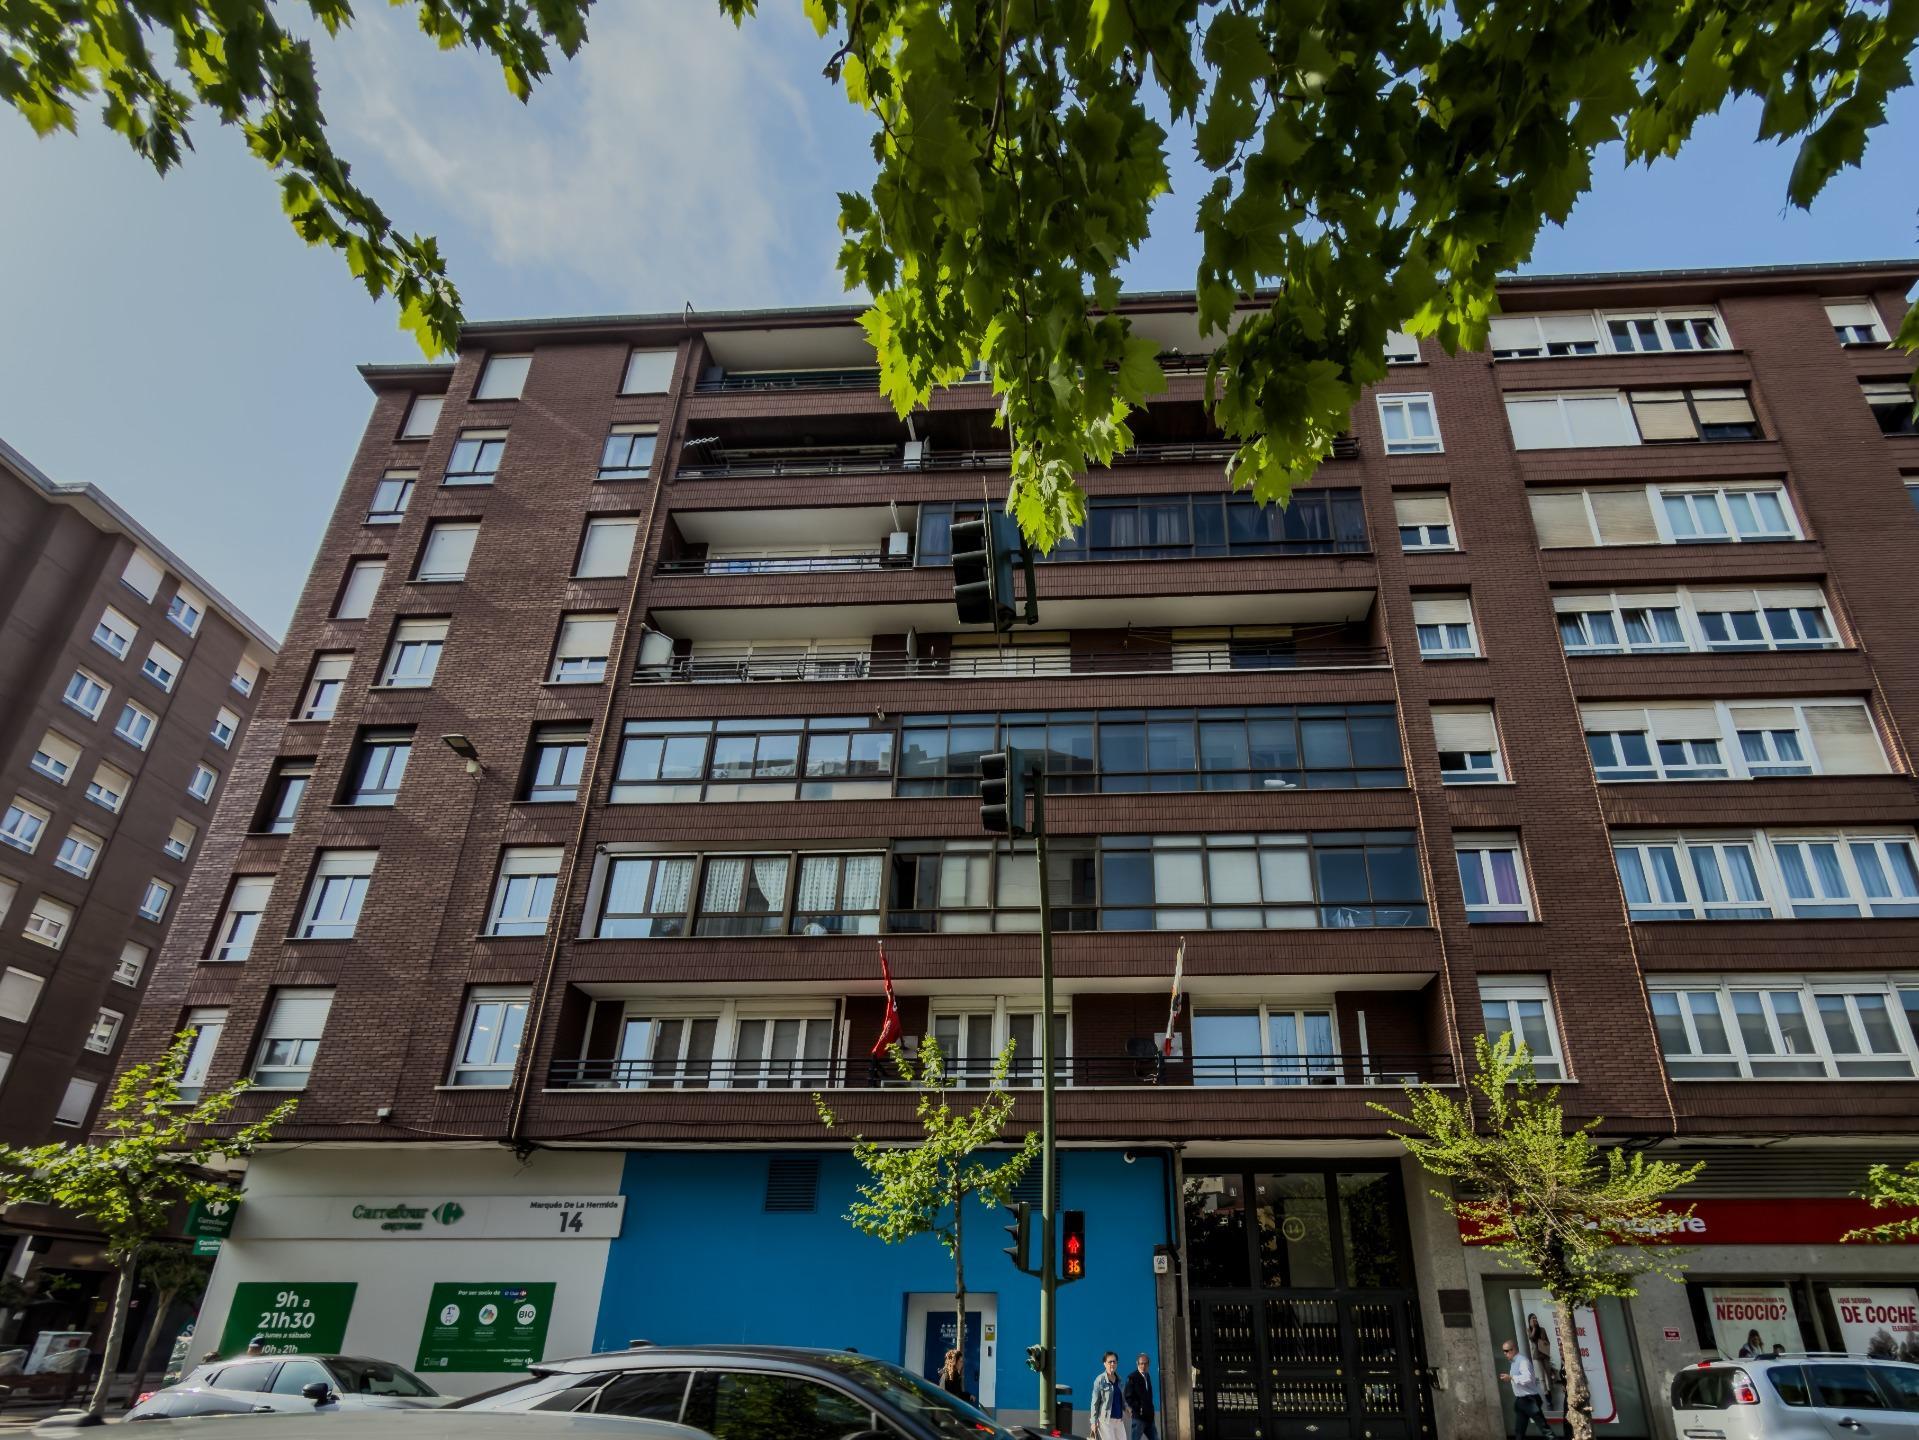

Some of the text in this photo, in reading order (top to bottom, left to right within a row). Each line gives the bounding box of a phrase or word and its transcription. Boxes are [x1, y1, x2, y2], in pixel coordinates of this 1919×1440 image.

[352, 1204, 429, 1219] Carrefour
[530, 1201, 563, 1210] Marqués
[560, 1212, 583, 1232] 14
[1068, 1260, 1081, 1273] 36
[275, 1291, 311, 1308] 9h a
[518, 1310, 534, 1318] BIO
[1716, 1304, 1787, 1320] NEGOCIO?
[1841, 1306, 1917, 1323] DE COCHE
[257, 1312, 316, 1329] 21h30
[282, 1345, 298, 1354] 21h
